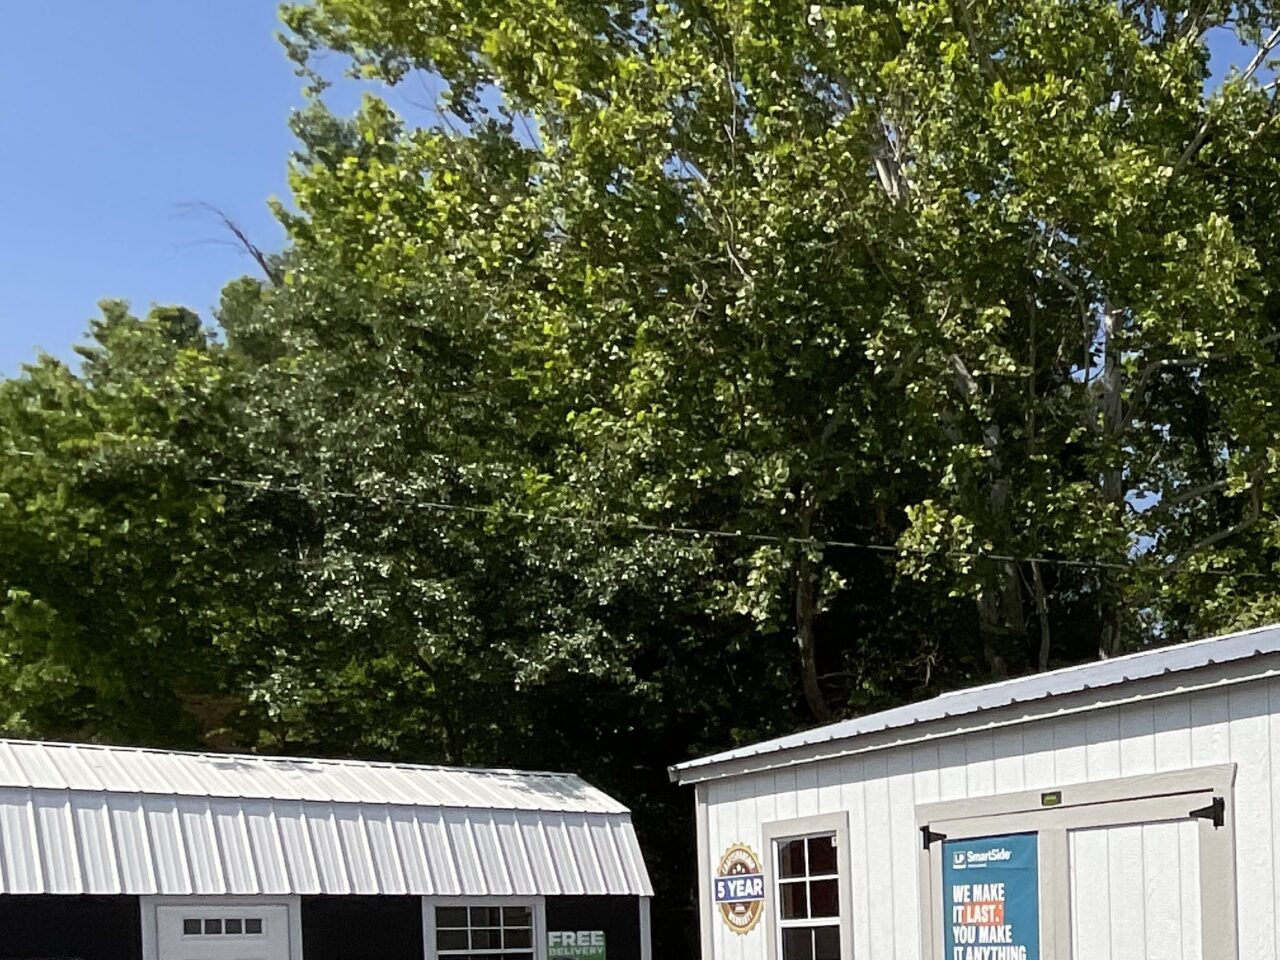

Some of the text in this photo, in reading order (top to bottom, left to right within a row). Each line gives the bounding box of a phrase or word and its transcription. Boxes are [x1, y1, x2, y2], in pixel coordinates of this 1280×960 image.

[717, 878, 763, 899] 5 YEAR
[953, 882, 1005, 902] WE MAKE
[953, 905, 964, 923] IT
[548, 930, 604, 946] FREE
[953, 924, 1012, 944] YOU MAKE
[548, 946, 604, 957] DELIVERY
